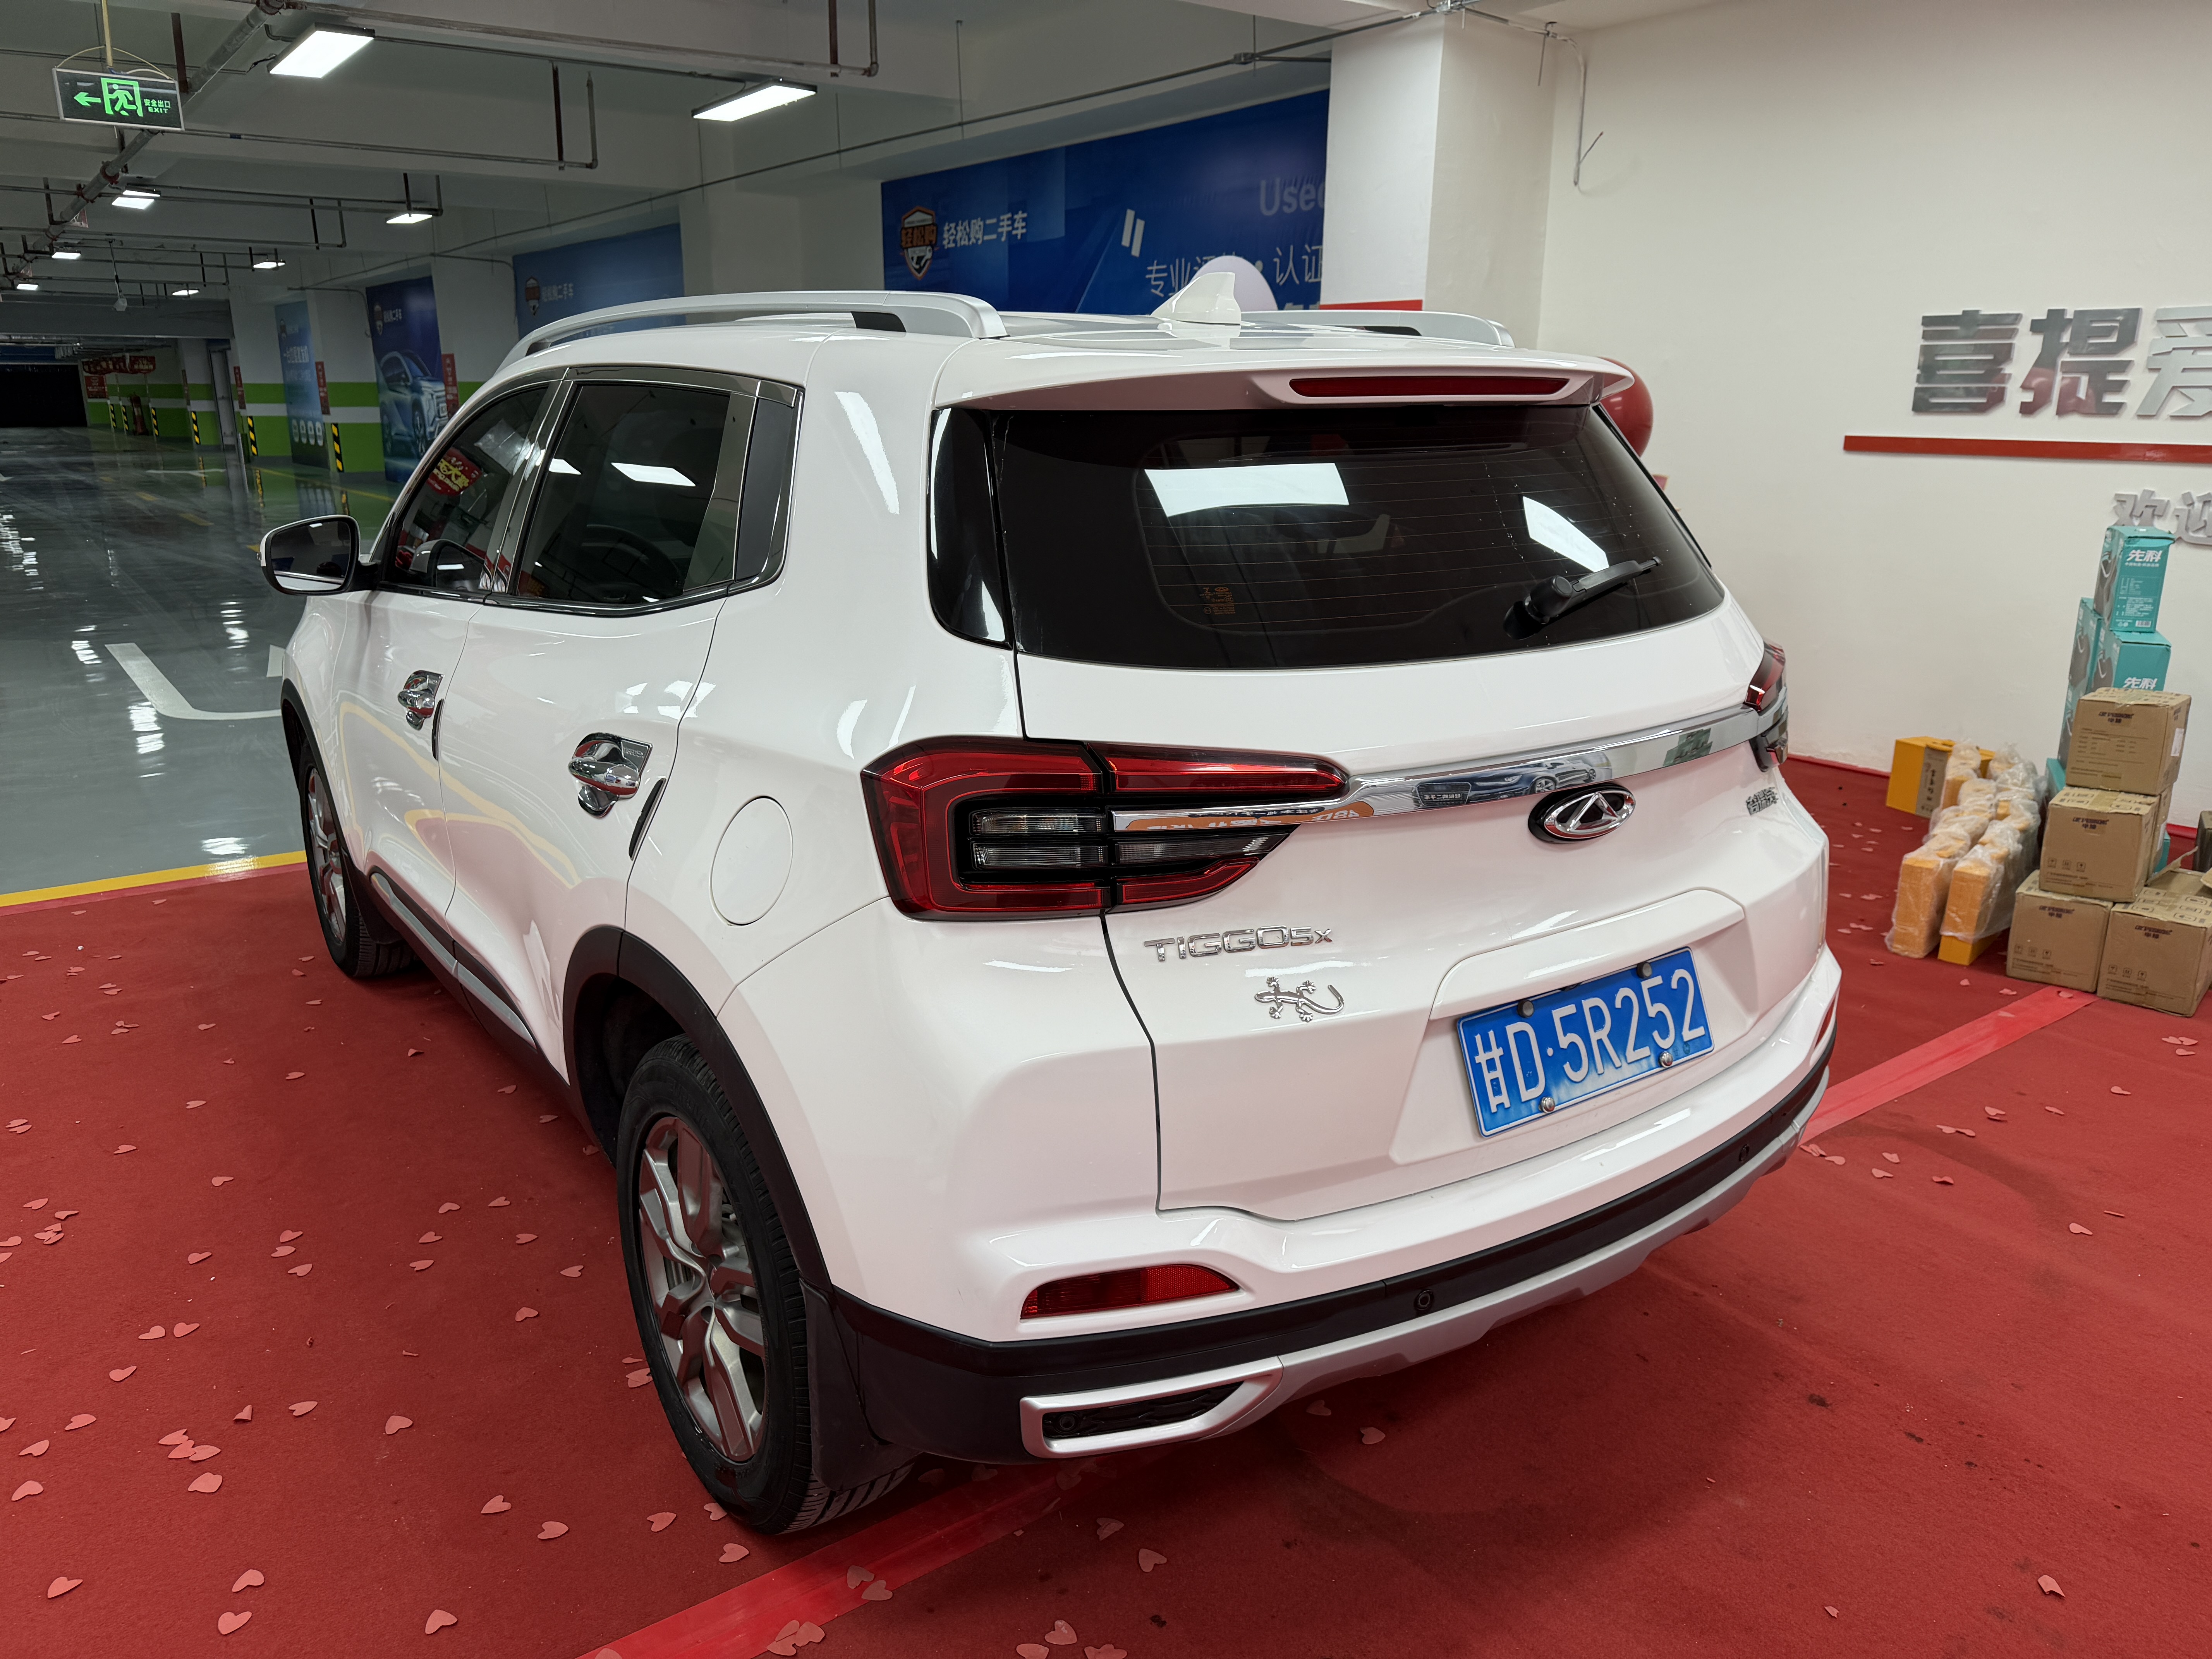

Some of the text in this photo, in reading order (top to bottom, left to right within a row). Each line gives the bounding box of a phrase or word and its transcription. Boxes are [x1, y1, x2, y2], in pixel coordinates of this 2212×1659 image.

[144, 99, 171, 108] 安全出口
[943, 211, 1027, 249] 轻松购二手车
[1912, 306, 2212, 417] 喜提爱
[2126, 550, 2162, 562] 先科
[2123, 677, 2158, 689] 先科
[1474, 969, 1705, 1113] 甘D·5R252
